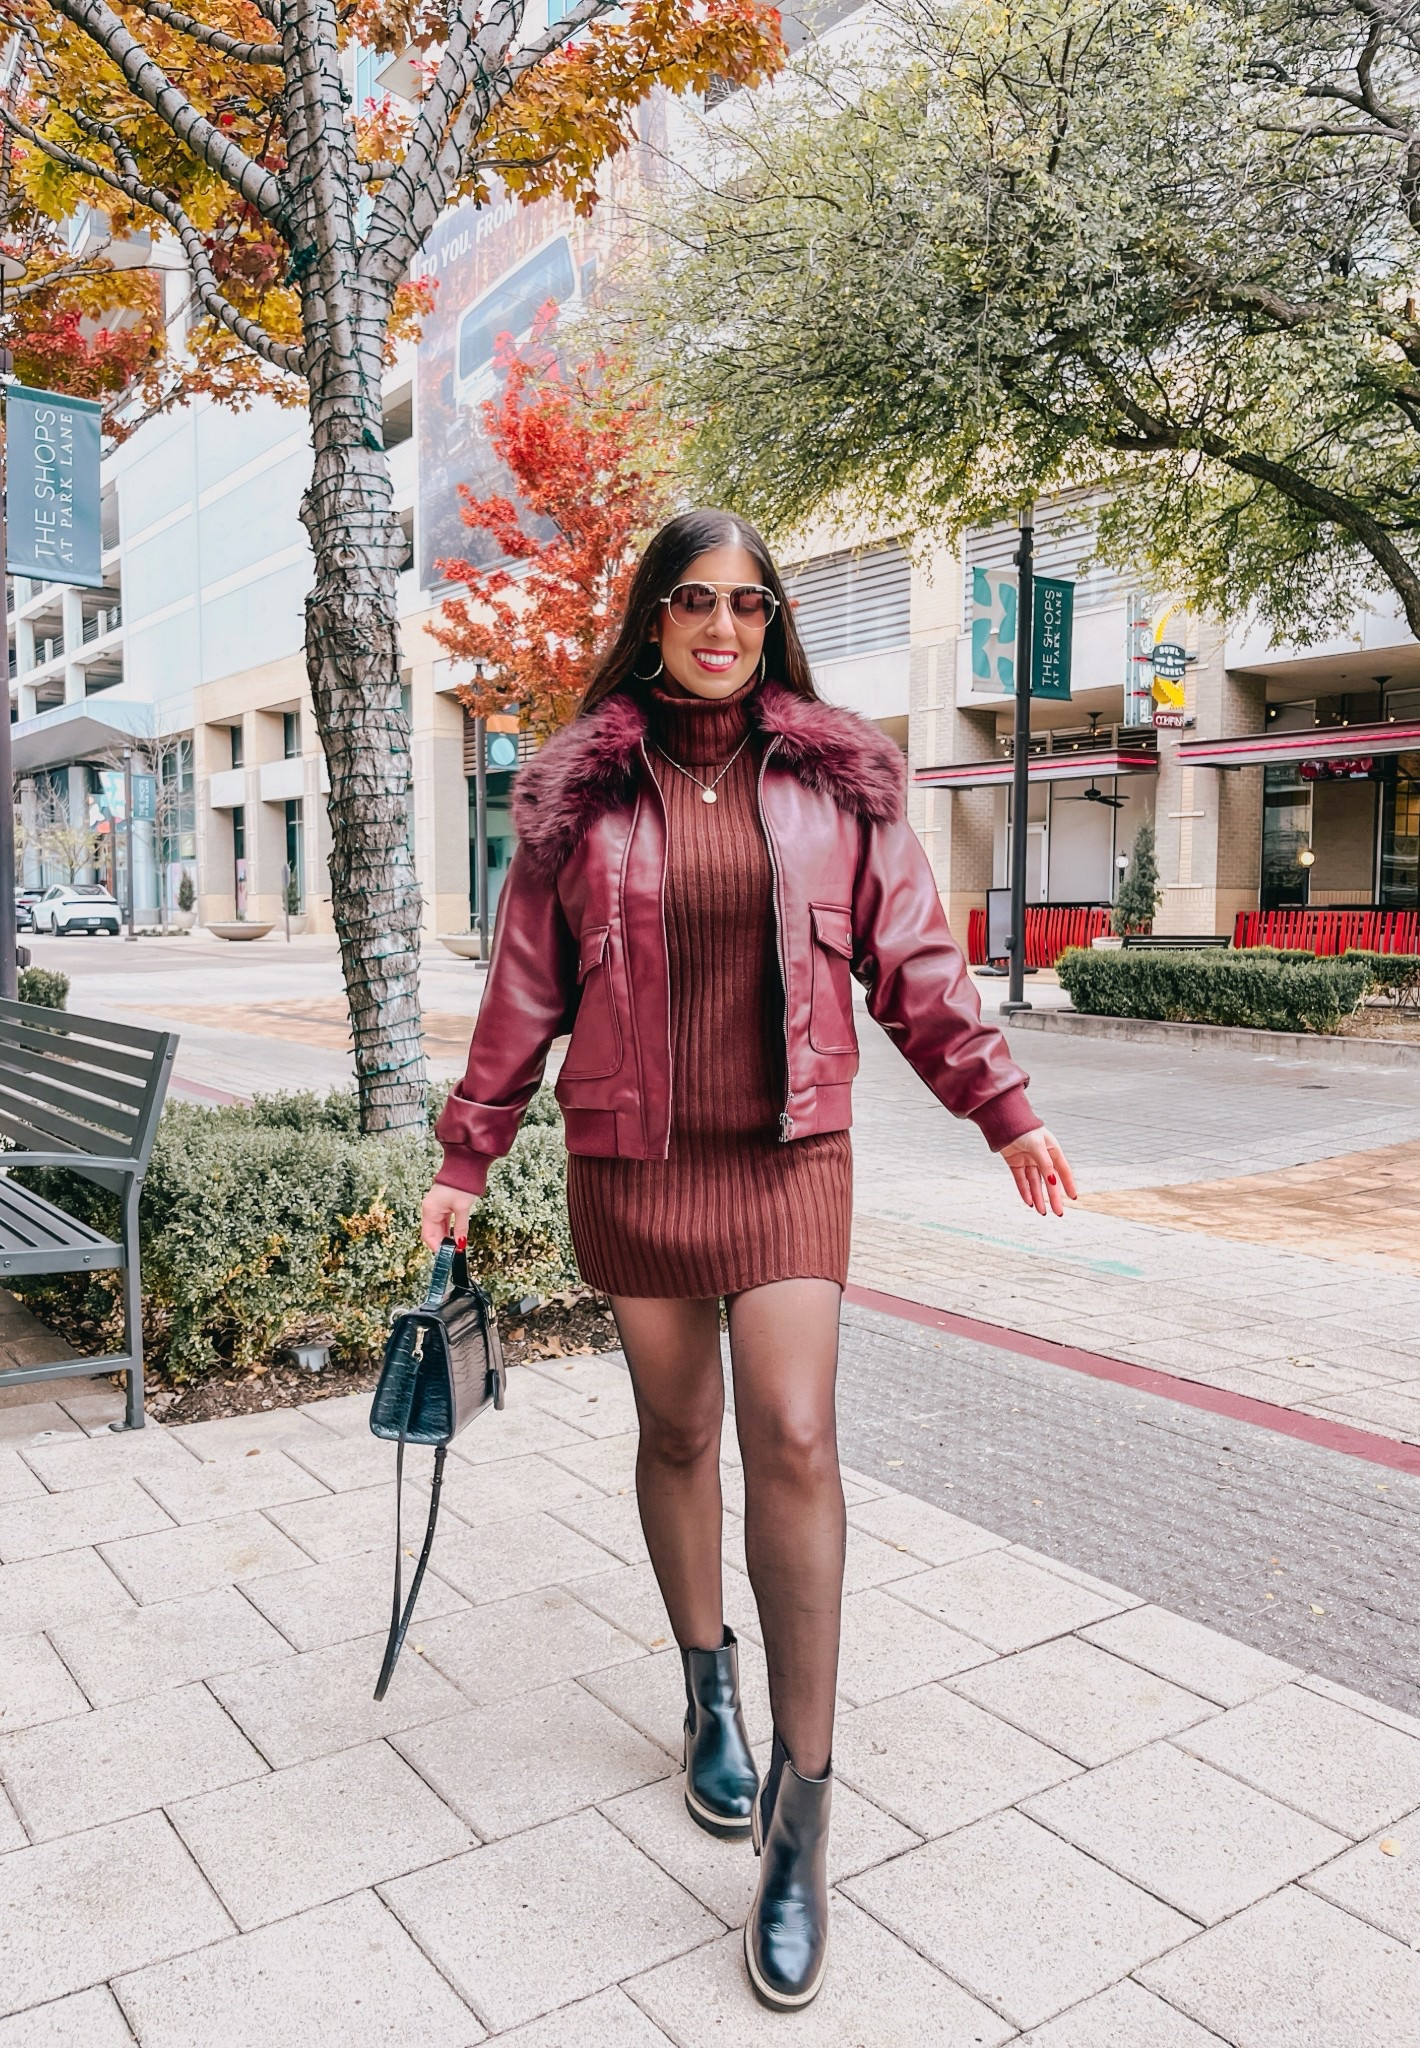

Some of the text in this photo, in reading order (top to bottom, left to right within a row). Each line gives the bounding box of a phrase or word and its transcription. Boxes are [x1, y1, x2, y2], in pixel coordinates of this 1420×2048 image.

[420, 198, 518, 277] TO YOU. FROM
[34, 408, 56, 558] THE SHOPS
[60, 413, 73, 563] AT PARK LANE
[1042, 590, 1055, 686] THE SHOPS
[1053, 591, 1063, 687] AT PARK LANE
[1155, 664, 1185, 676] BARREL
[1159, 646, 1180, 656] BOWL
